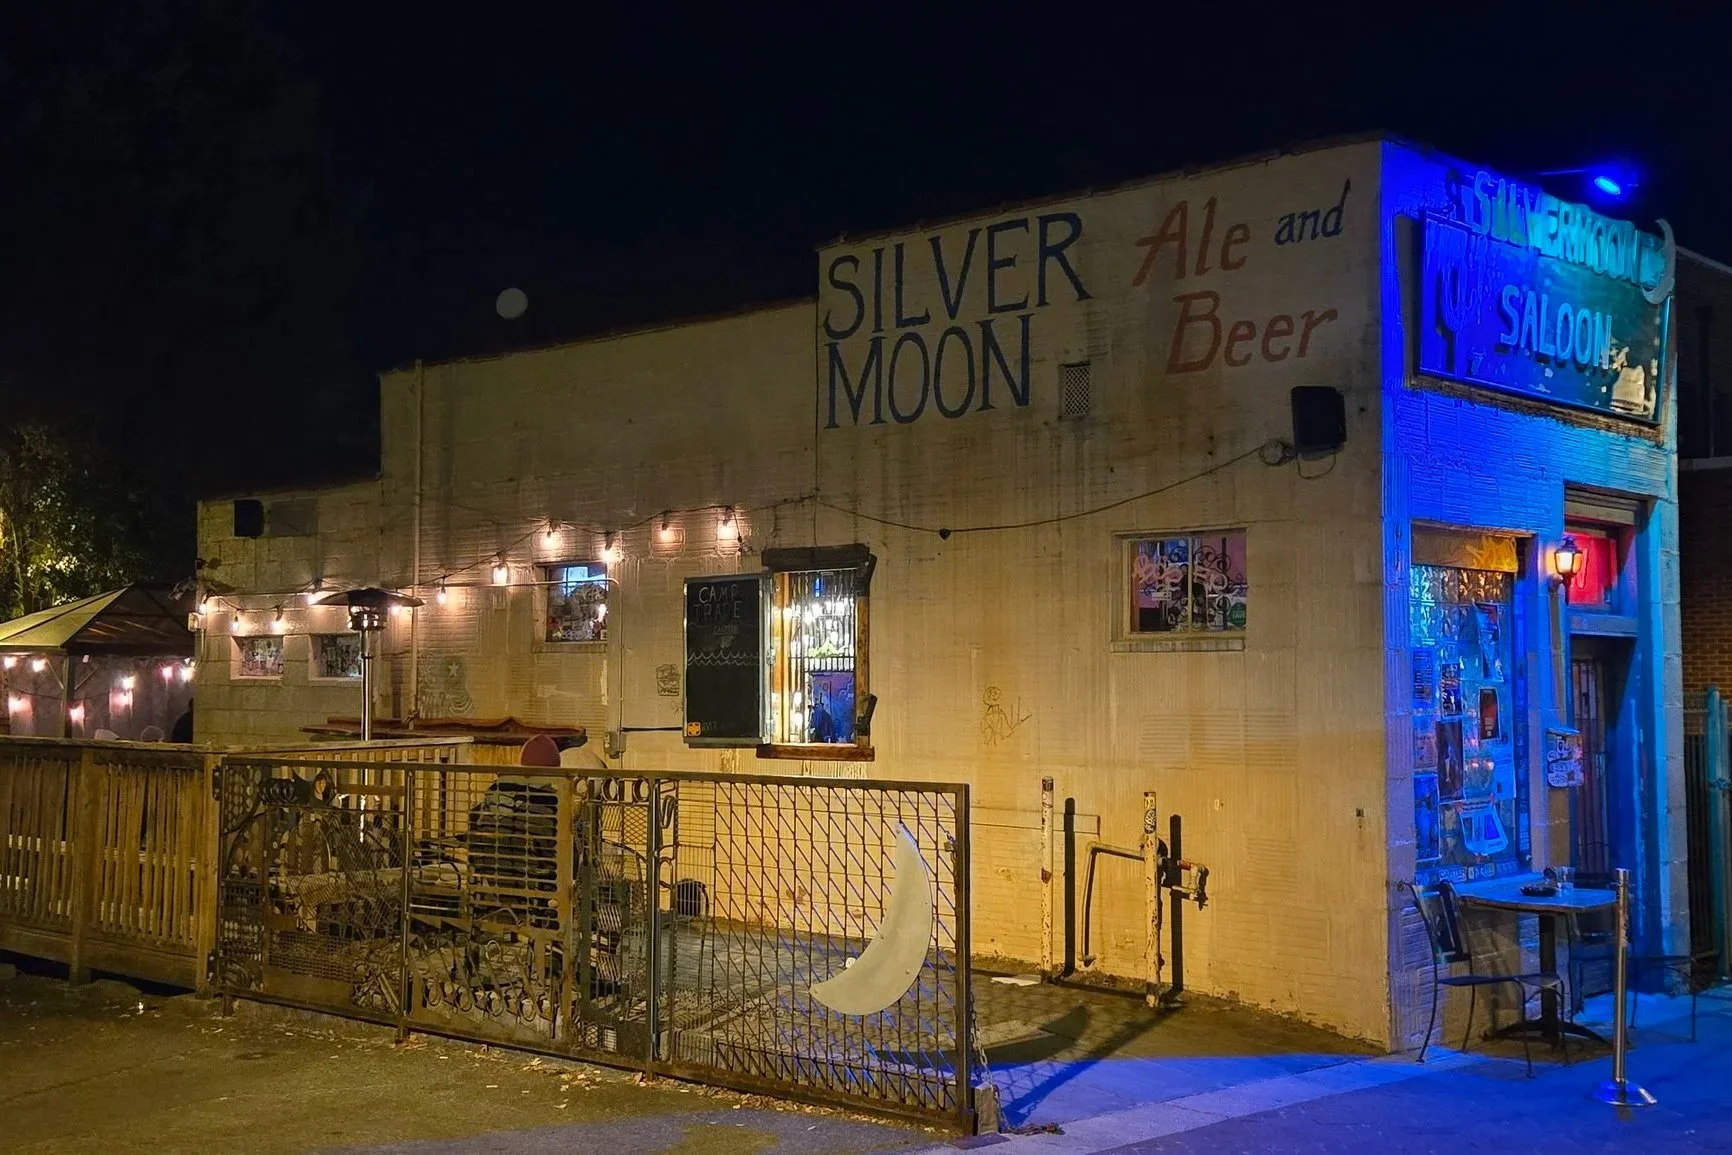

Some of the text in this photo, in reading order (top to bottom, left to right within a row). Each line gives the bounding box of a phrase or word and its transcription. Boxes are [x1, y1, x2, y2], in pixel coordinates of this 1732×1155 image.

[823, 212, 1092, 338] SILVER
[1133, 178, 1351, 287] Ale and
[823, 314, 1033, 429] MOON
[1166, 291, 1337, 374] Beer
[1501, 285, 1612, 369] SALOON
[693, 601, 742, 624] TRAE
